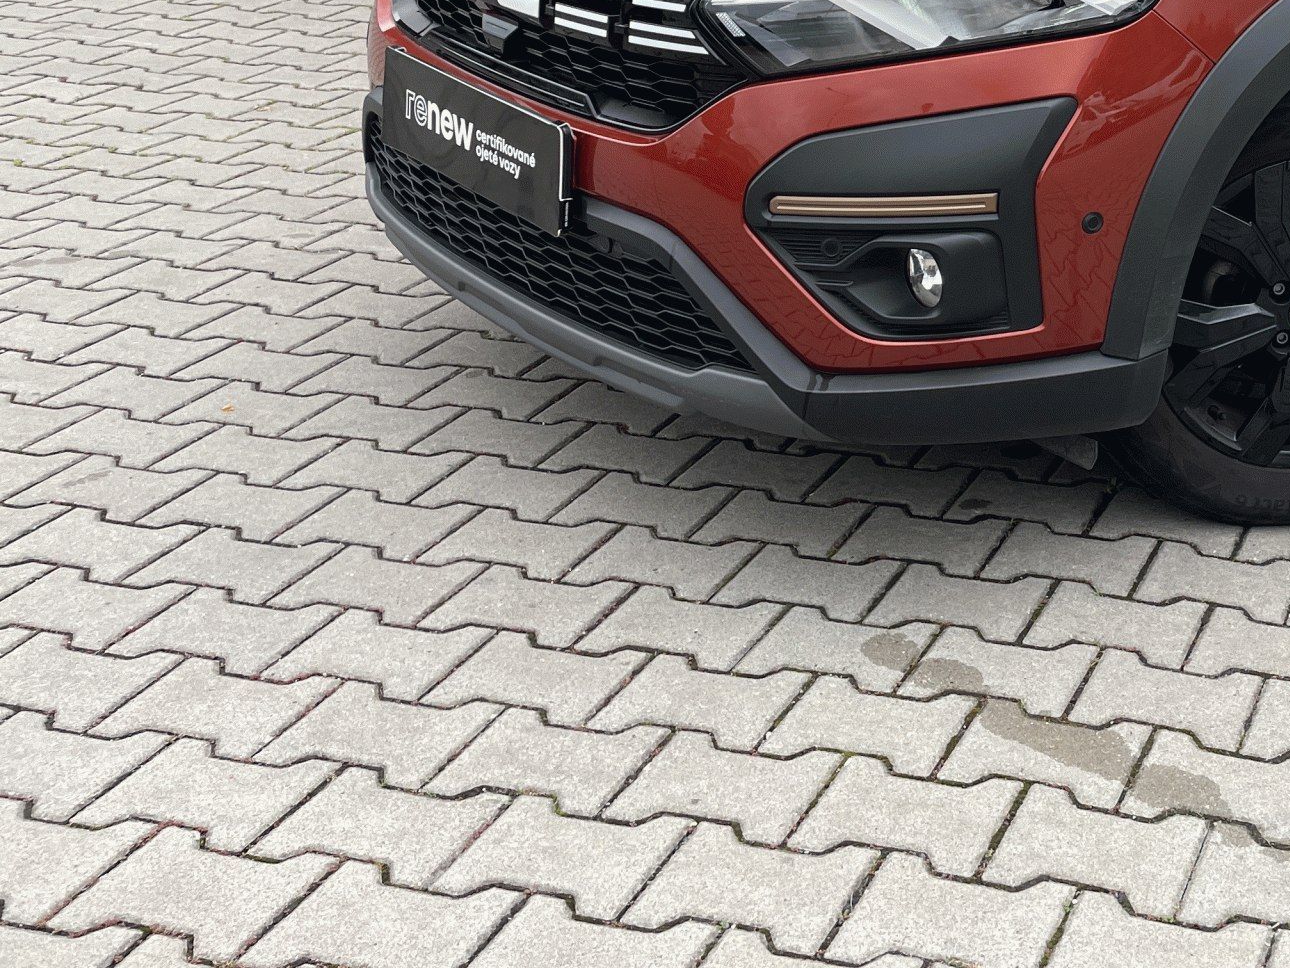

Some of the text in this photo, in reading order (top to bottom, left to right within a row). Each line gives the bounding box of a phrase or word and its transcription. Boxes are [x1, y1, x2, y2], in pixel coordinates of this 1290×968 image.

[405, 88, 474, 151] renew
[475, 129, 536, 168] certifikované
[475, 144, 521, 179] ojeté vozy
